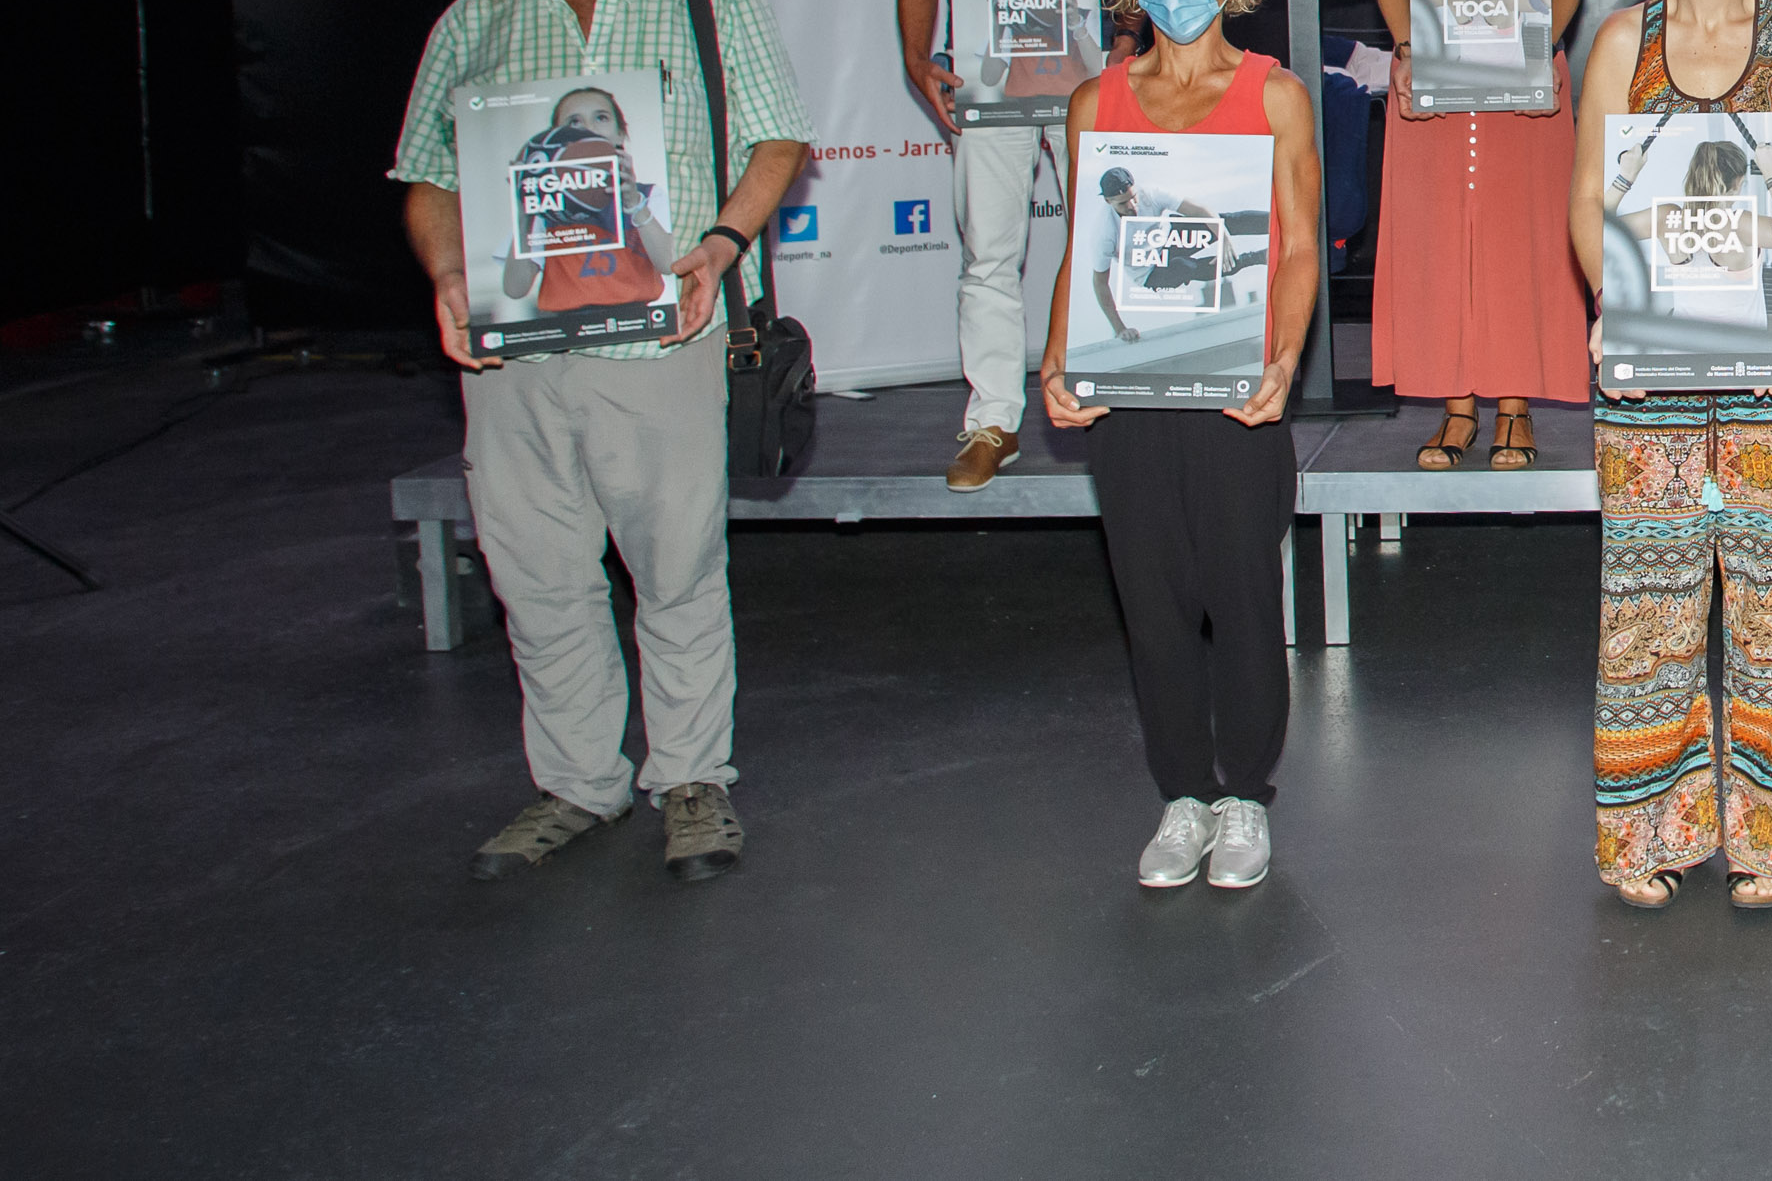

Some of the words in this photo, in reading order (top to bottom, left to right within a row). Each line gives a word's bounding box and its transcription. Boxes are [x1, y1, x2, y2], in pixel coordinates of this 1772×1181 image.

[997, 11, 1027, 25] BAI
[1453, 0, 1509, 17] TOCA
[811, 144, 877, 161] uenos
[521, 170, 608, 194] #GAUR
[524, 193, 565, 215] BAI
[1665, 208, 1745, 231] #HOY
[879, 240, 950, 255] @DeporteKirola
[1132, 229, 1213, 249] #GAUR
[1665, 231, 1744, 254] TOCA
[1131, 248, 1168, 268] BAI
